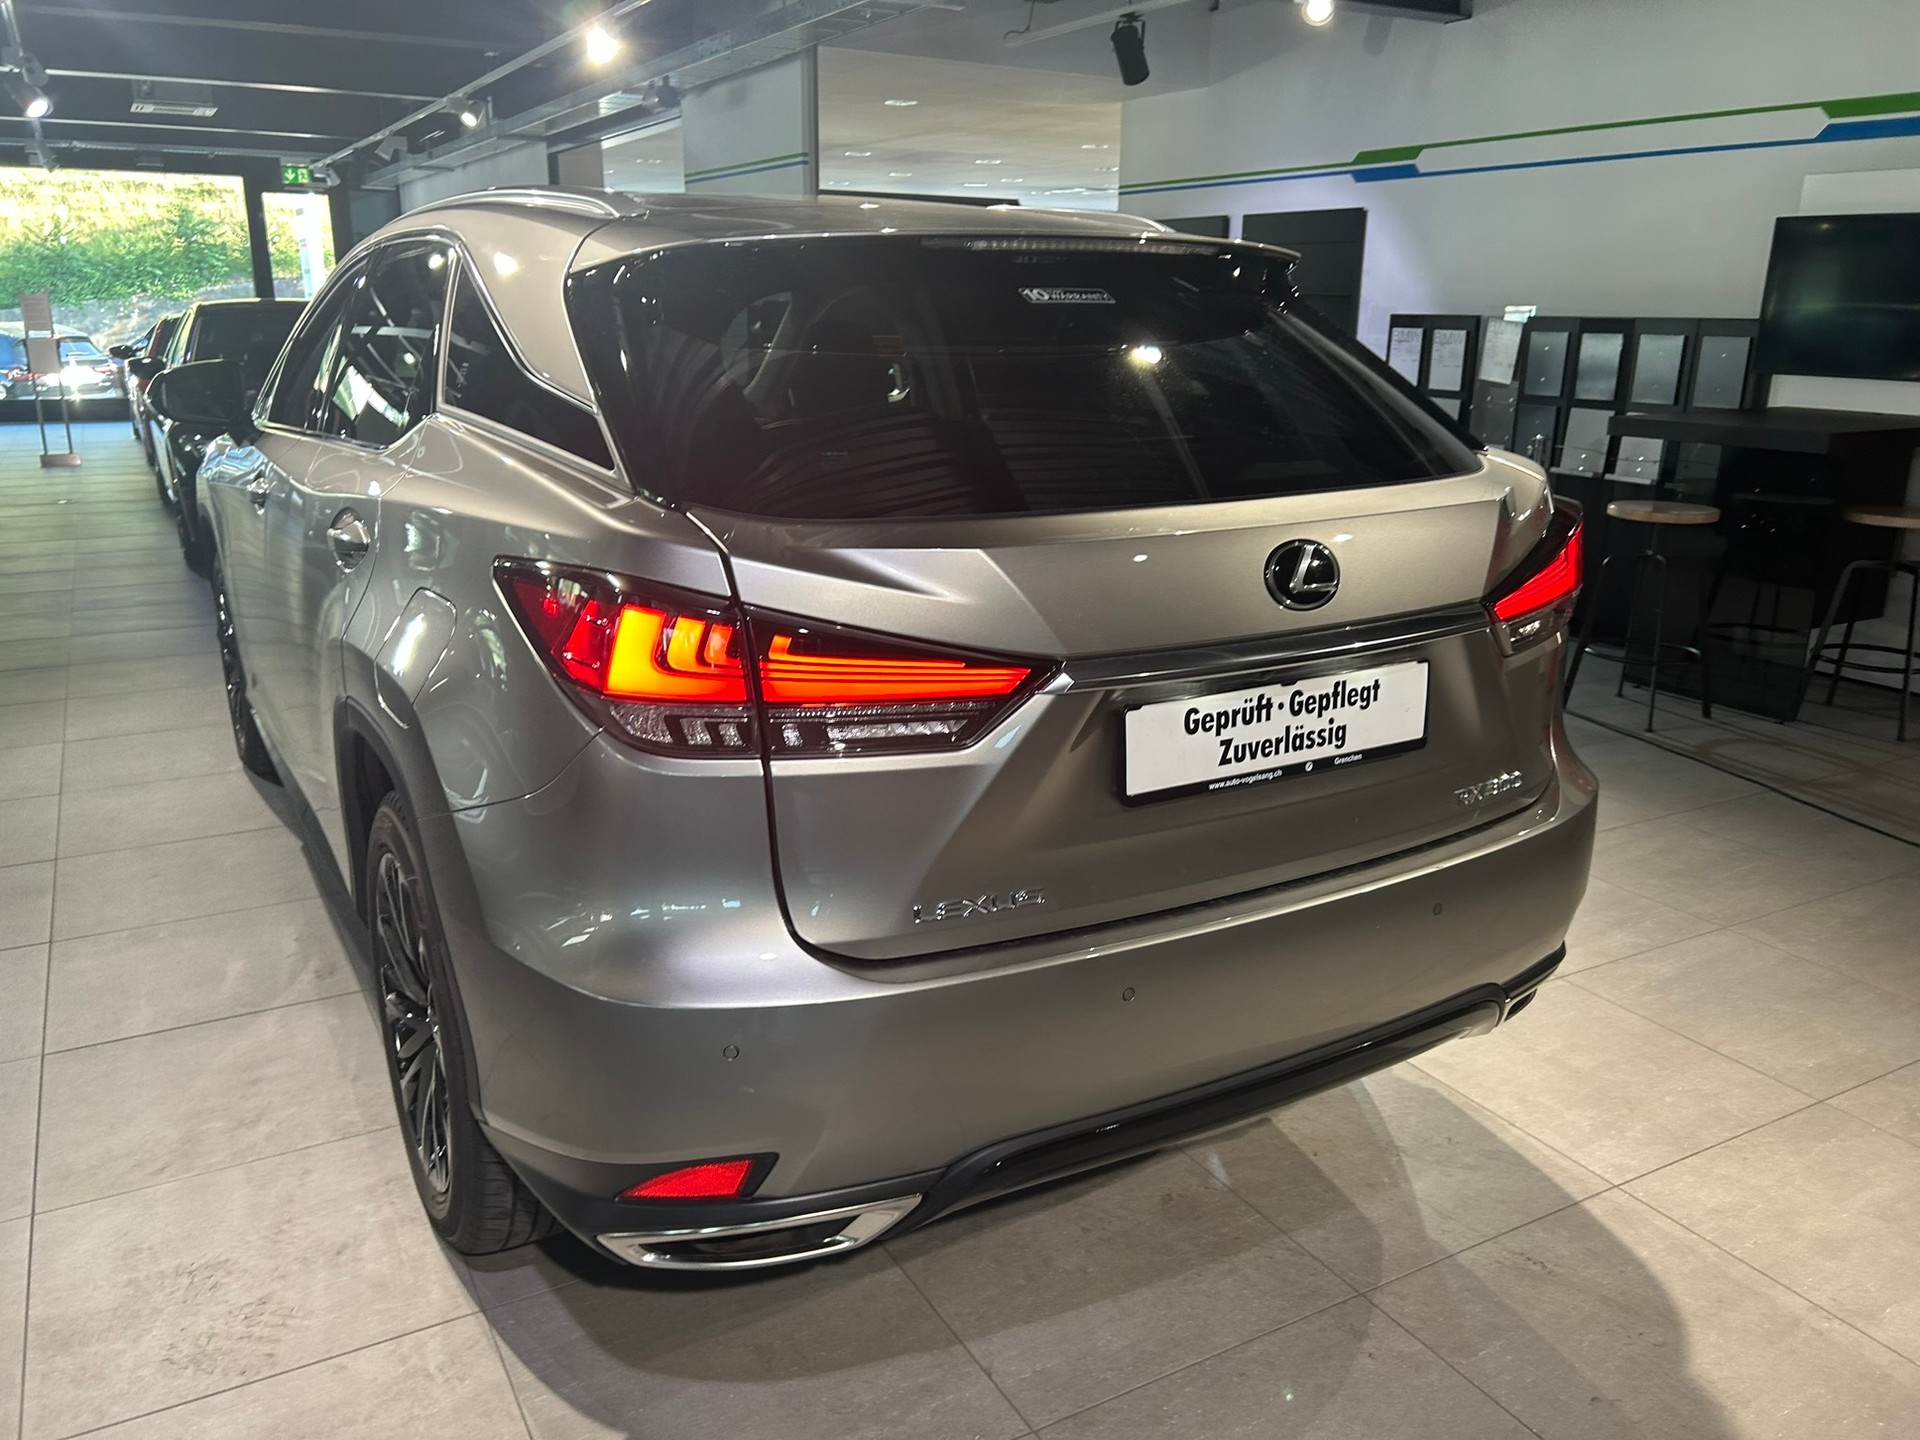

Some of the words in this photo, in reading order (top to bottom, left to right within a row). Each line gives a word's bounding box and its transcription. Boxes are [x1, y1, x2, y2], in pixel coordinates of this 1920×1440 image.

[1184, 694, 1273, 737] Geprüft
[1289, 679, 1381, 719] Gepflegt
[1218, 718, 1348, 767] Zuverlässig
[1208, 769, 1283, 791] www.auto-vogelsang.ch
[1334, 753, 1363, 766] Grenchen
[913, 887, 1046, 924] LEXUS
